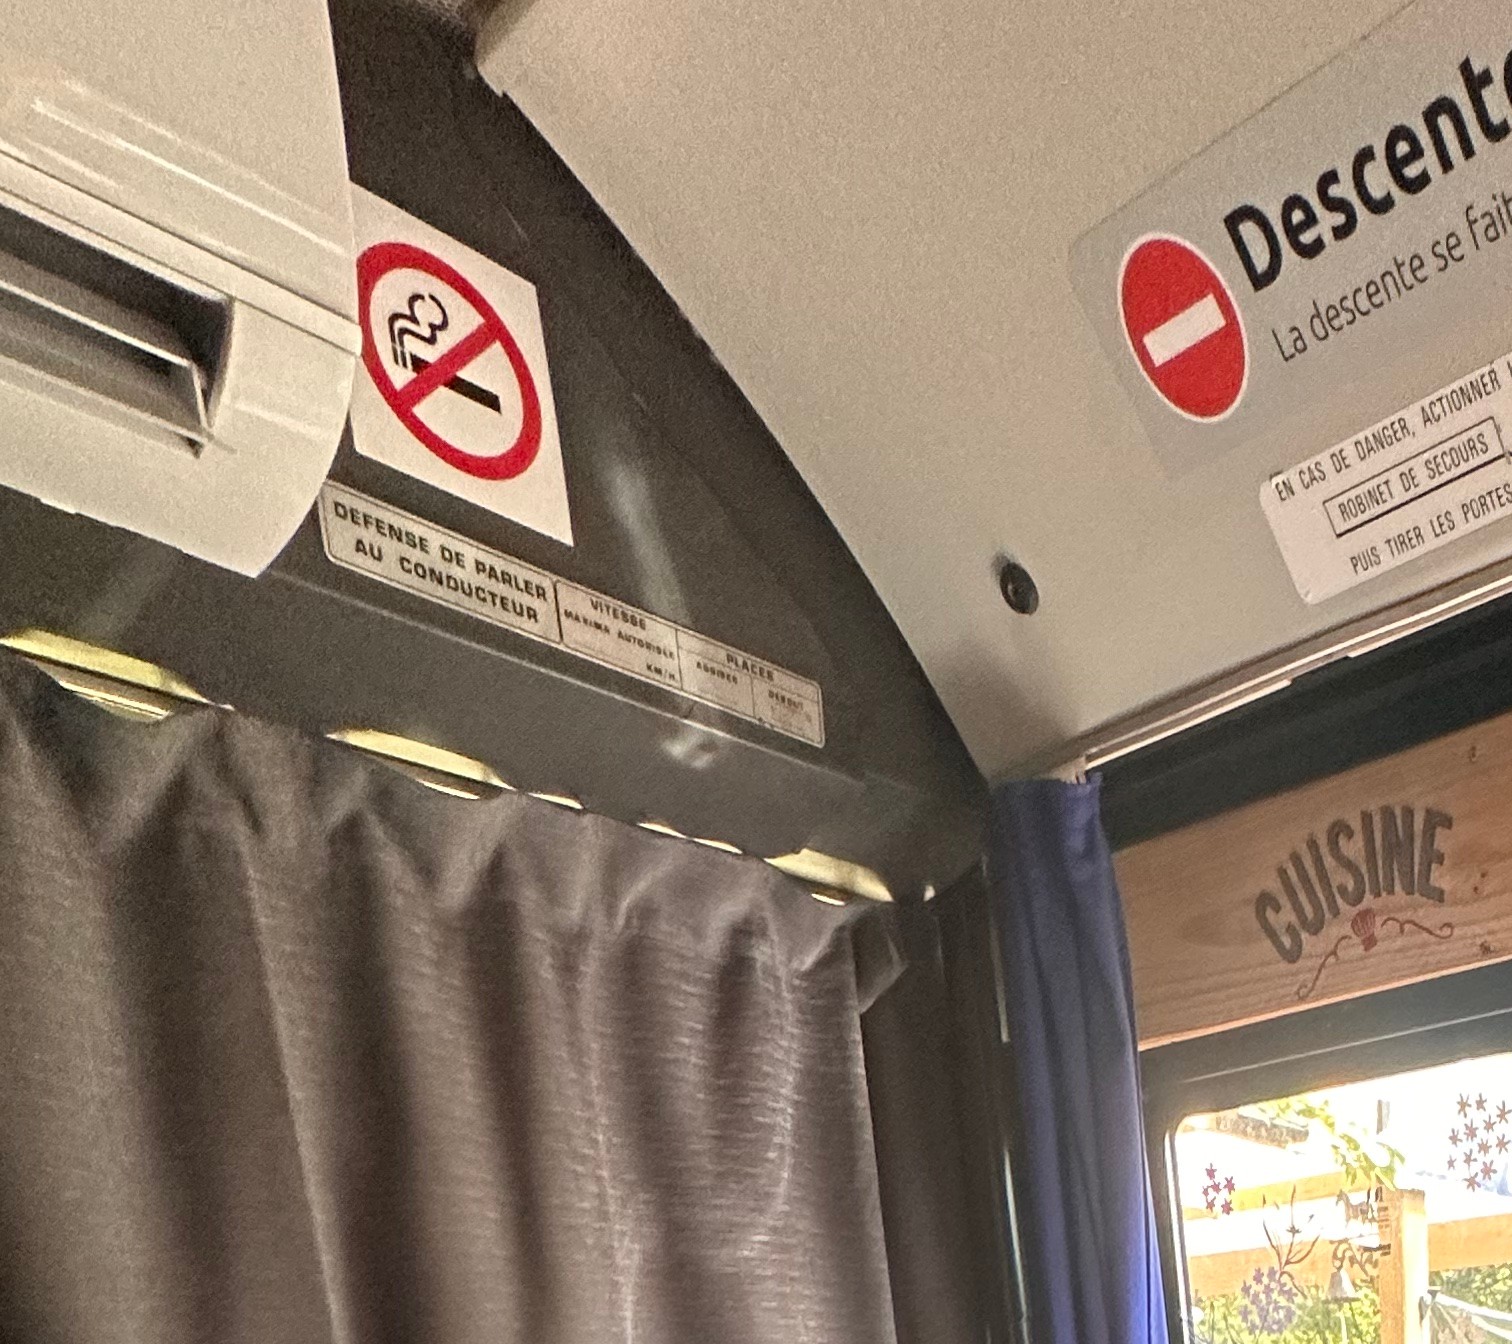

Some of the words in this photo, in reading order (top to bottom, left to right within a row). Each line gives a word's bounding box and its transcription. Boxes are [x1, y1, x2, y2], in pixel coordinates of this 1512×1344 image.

[1271, 327, 1308, 363] La
[1309, 251, 1429, 342] descente
[1431, 230, 1465, 273] se
[1275, 480, 1295, 502] EN
[1300, 460, 1327, 490] CAS
[1330, 448, 1351, 474] DE
[1354, 416, 1417, 461] DANGER,
[1420, 367, 1502, 427] ACTIONNER
[1337, 480, 1395, 523] ROBINET
[1399, 467, 1420, 493] DE
[1424, 432, 1490, 481] SECOURS
[333, 501, 431, 554] DEFENSE
[439, 544, 467, 570] DE
[474, 558, 548, 602] PARLER
[354, 538, 384, 563] AU
[399, 556, 540, 624] CONDUCTEUR
[1350, 545, 1382, 576] PUIS
[1385, 526, 1426, 557] TIRER
[1429, 509, 1457, 539] LES
[590, 598, 647, 631] VITESSE
[726, 652, 775, 682] PLACES
[1253, 804, 1454, 965] CUISINE
